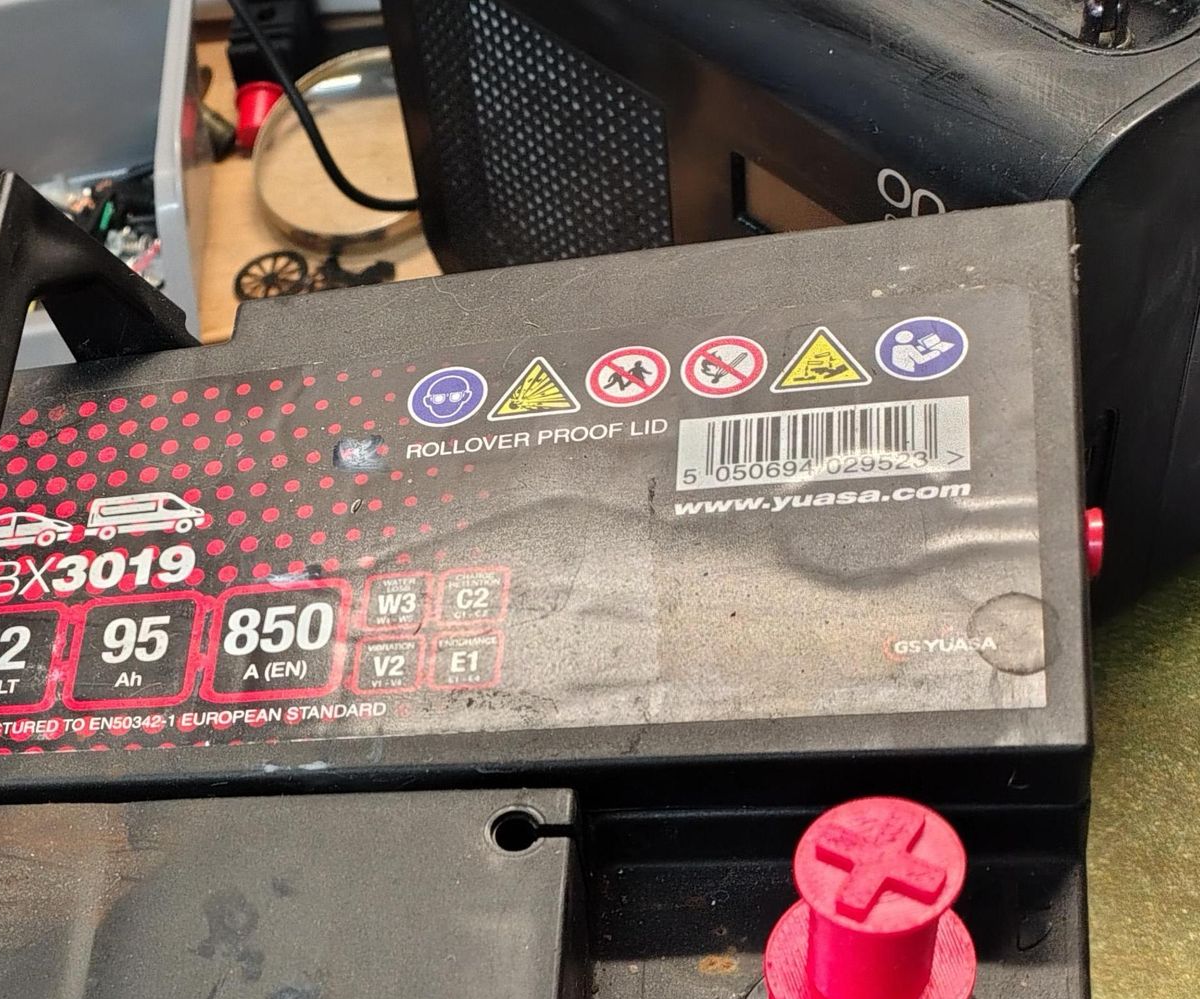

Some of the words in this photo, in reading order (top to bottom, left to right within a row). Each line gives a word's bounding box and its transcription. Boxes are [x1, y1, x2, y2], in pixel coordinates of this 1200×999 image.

[406, 431, 531, 459] ROLLOVER
[537, 422, 624, 446] PROOF
[630, 418, 669, 437] LID
[682, 468, 698, 485] 5
[715, 458, 814, 483] 050694
[826, 450, 929, 475] 029523
[673, 482, 972, 516] www.yuasa.com
[377, 593, 417, 616] W3
[456, 587, 490, 610] C2
[101, 615, 172, 665] 95
[222, 601, 335, 657] 850
[894, 640, 922, 653] GS
[924, 636, 998, 653] YUASA
[243, 664, 260, 681] A
[263, 660, 308, 683] (EN)
[373, 655, 406, 678] V2
[450, 650, 479, 673] E1
[114, 671, 143, 688] Ah
[64, 718, 86, 732] TO
[89, 714, 176, 731] EN50342-1
[181, 706, 283, 728] EUROPEAN
[286, 702, 388, 721] STANDARD
